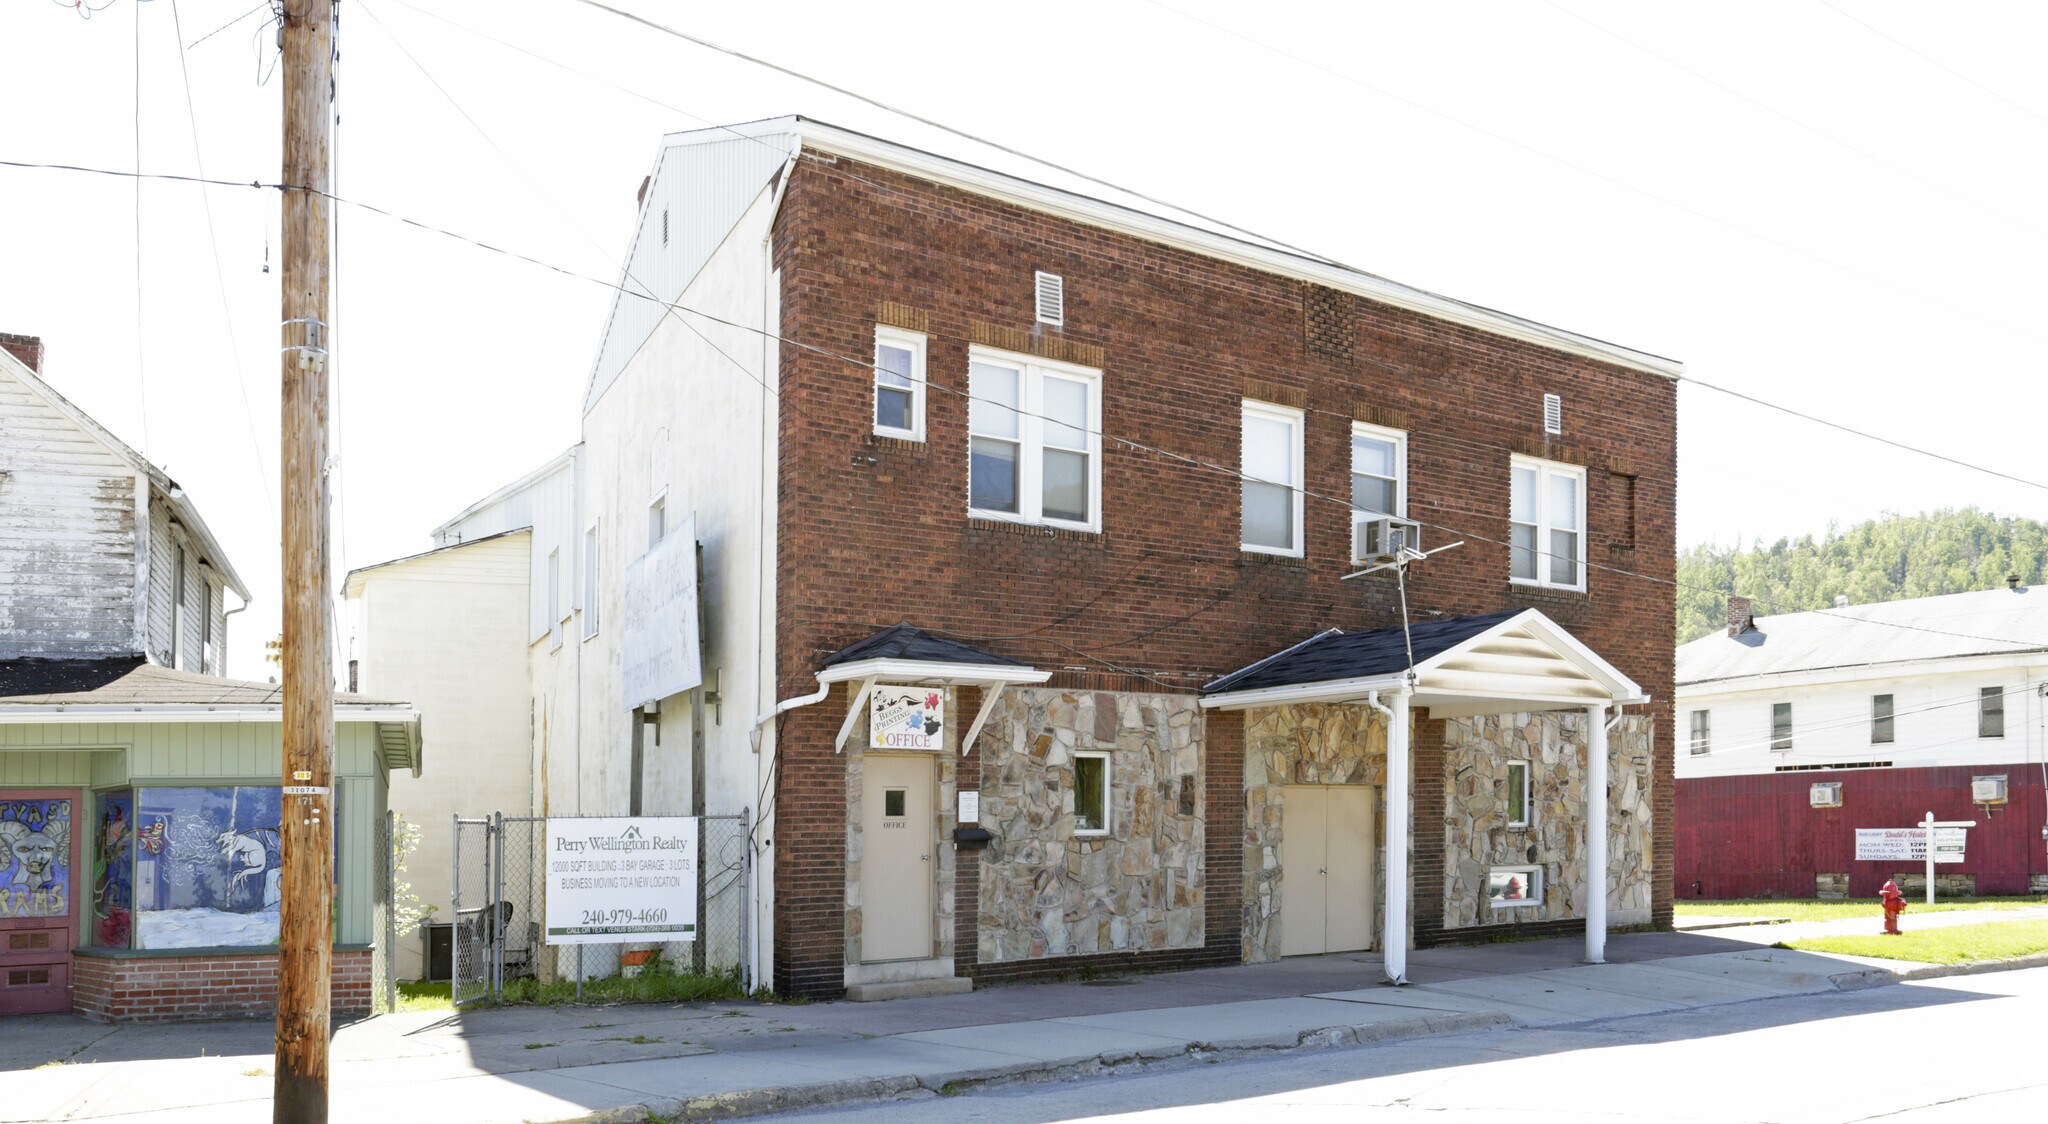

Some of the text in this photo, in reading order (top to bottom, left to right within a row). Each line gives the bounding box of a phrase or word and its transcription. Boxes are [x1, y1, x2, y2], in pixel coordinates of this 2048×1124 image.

[876, 710, 910, 730] PRINTING
[879, 705, 903, 721] BEGGS
[886, 732, 931, 747] OFFICE
[883, 821, 907, 829] OFFICE
[556, 836, 687, 854] Perry Wellington Realty
[552, 861, 569, 872] 12000
[571, 860, 587, 872] SQFT
[588, 860, 616, 871] BUILDING
[626, 860, 638, 871] BAY
[639, 859, 664, 870] GARAGE
[674, 859, 690, 870] LOTS
[562, 878, 592, 889] BUSINESS
[593, 877, 618, 888] MOVING
[620, 877, 628, 888] TO
[634, 876, 649, 888] NEW
[650, 876, 681, 888] LOCATION
[582, 908, 667, 925] 240-979-4660
